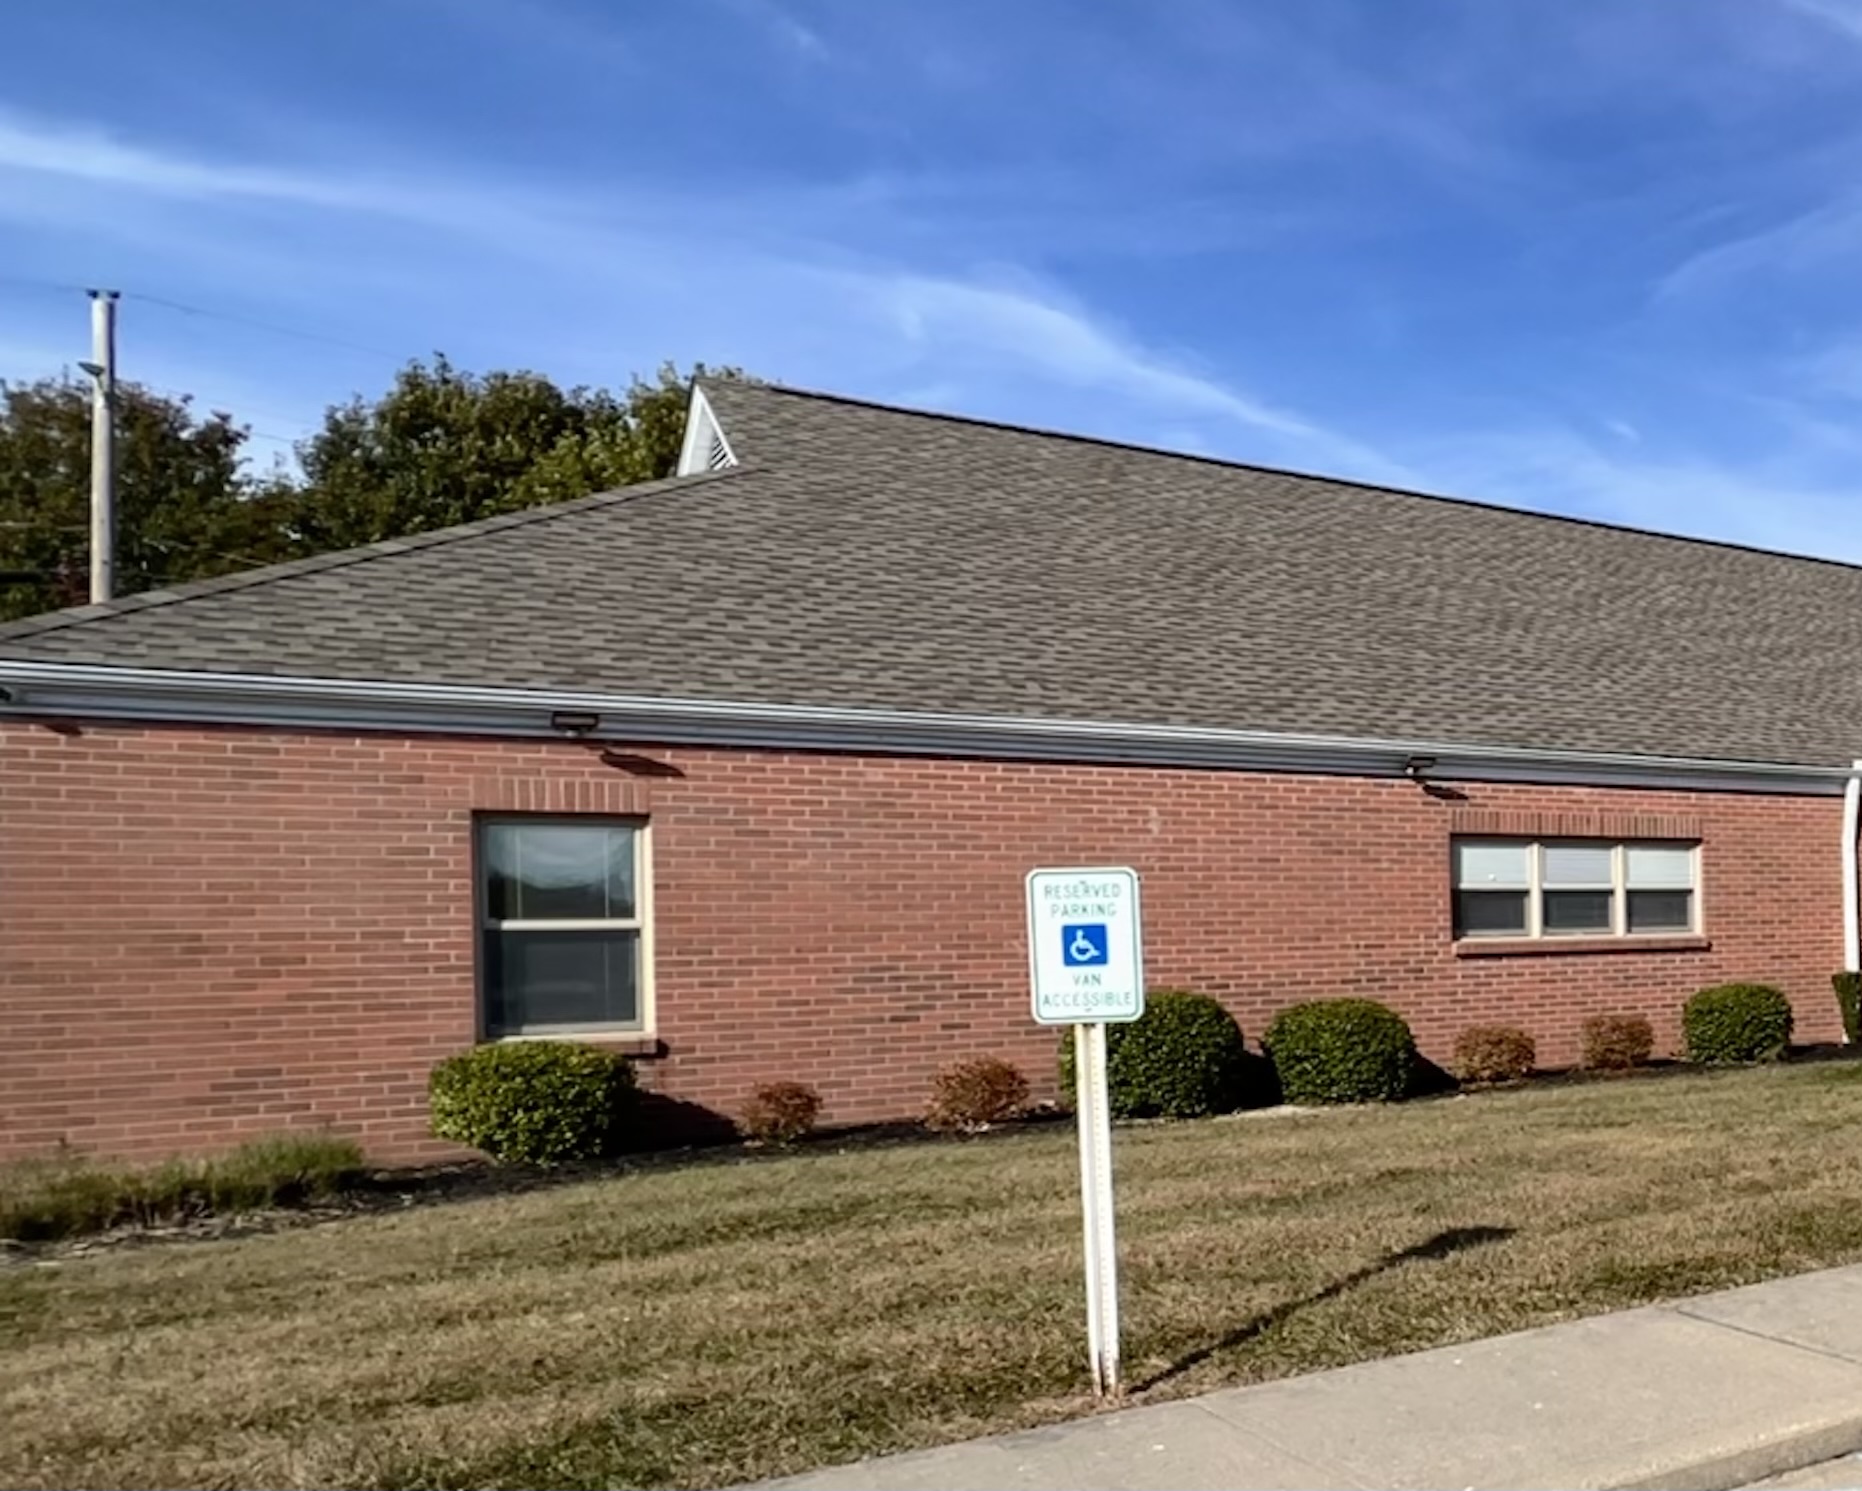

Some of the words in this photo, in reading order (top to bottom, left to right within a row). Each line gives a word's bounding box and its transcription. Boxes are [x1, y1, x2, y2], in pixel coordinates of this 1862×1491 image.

[1044, 883, 1121, 899] RESERVED
[1051, 903, 1117, 918] PARKING
[1073, 973, 1102, 987] VAN
[1042, 992, 1132, 1008] ACCESSIBLE
